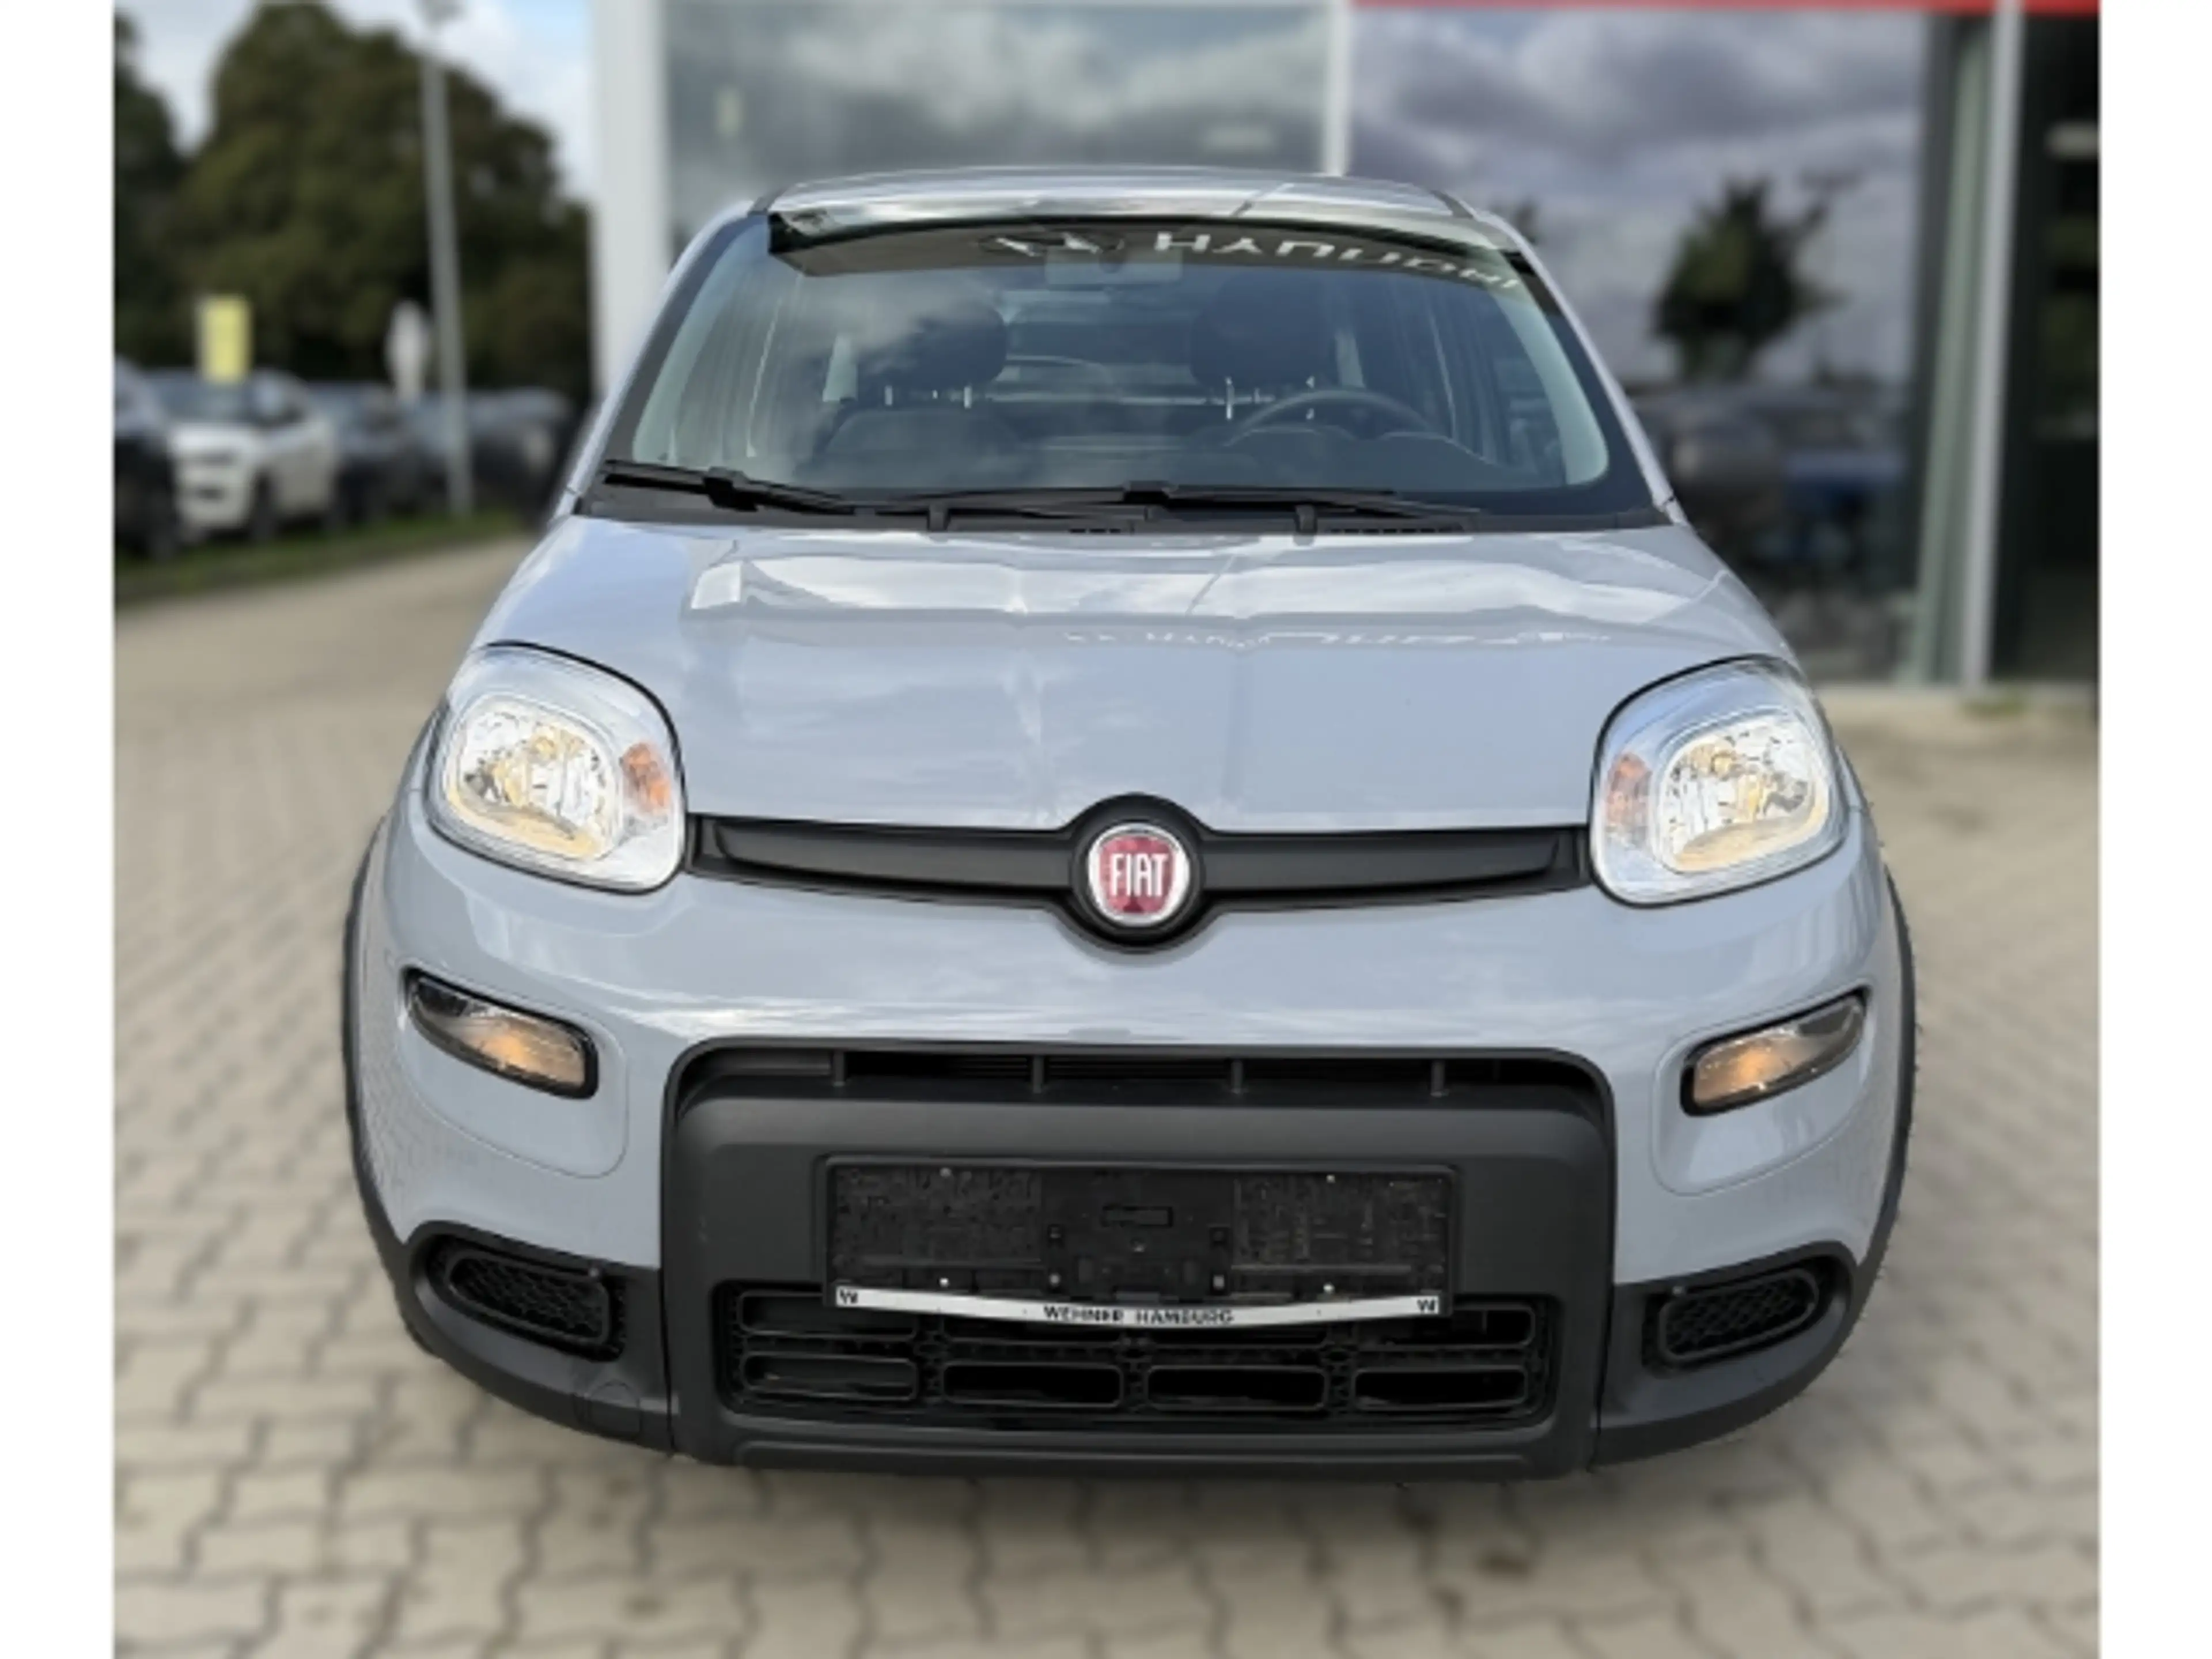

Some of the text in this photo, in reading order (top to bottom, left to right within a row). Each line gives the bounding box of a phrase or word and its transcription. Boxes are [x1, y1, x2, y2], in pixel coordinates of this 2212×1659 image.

[1109, 853, 1169, 897] FIAT
[1043, 1305, 1235, 1325] WEHNER HAMBURG
